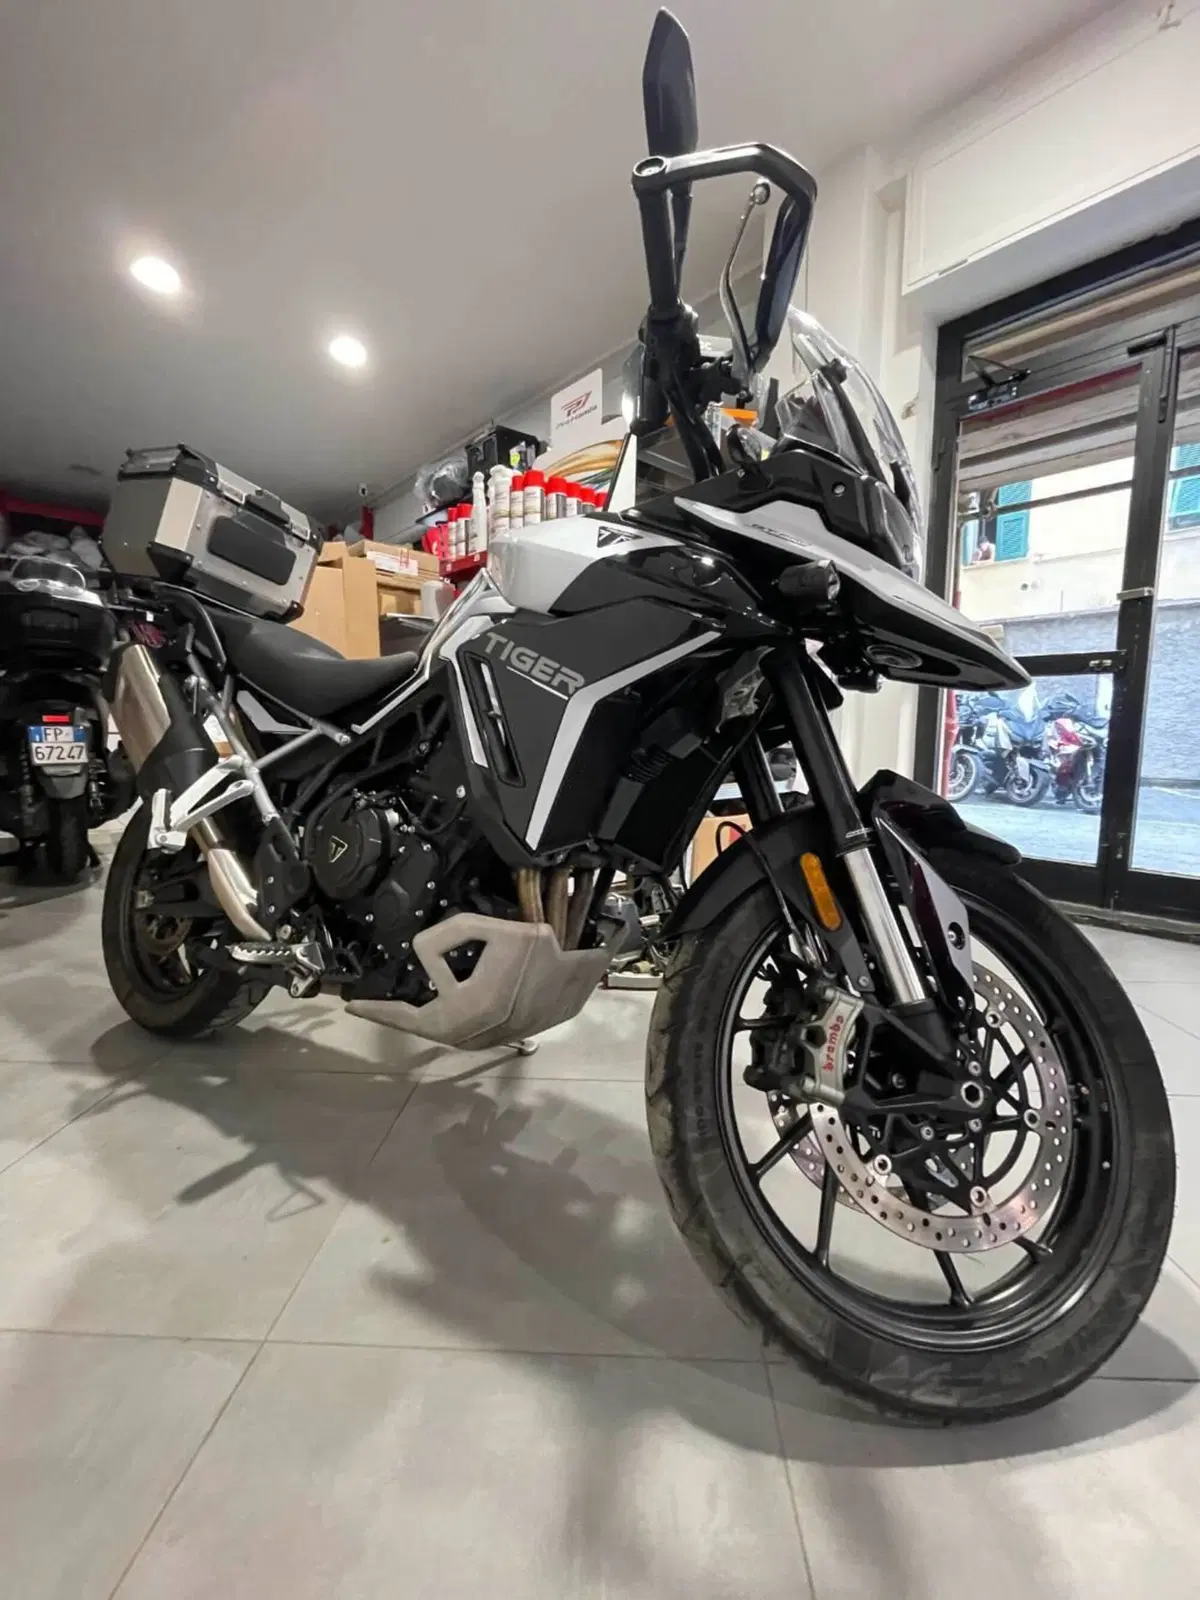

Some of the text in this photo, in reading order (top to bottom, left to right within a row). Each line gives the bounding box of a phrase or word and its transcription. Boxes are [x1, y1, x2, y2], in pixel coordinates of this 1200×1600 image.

[485, 632, 585, 694] TIGER
[34, 745, 85, 760] 67247
[43, 727, 64, 742] FP
[821, 1015, 845, 1072] brembo
